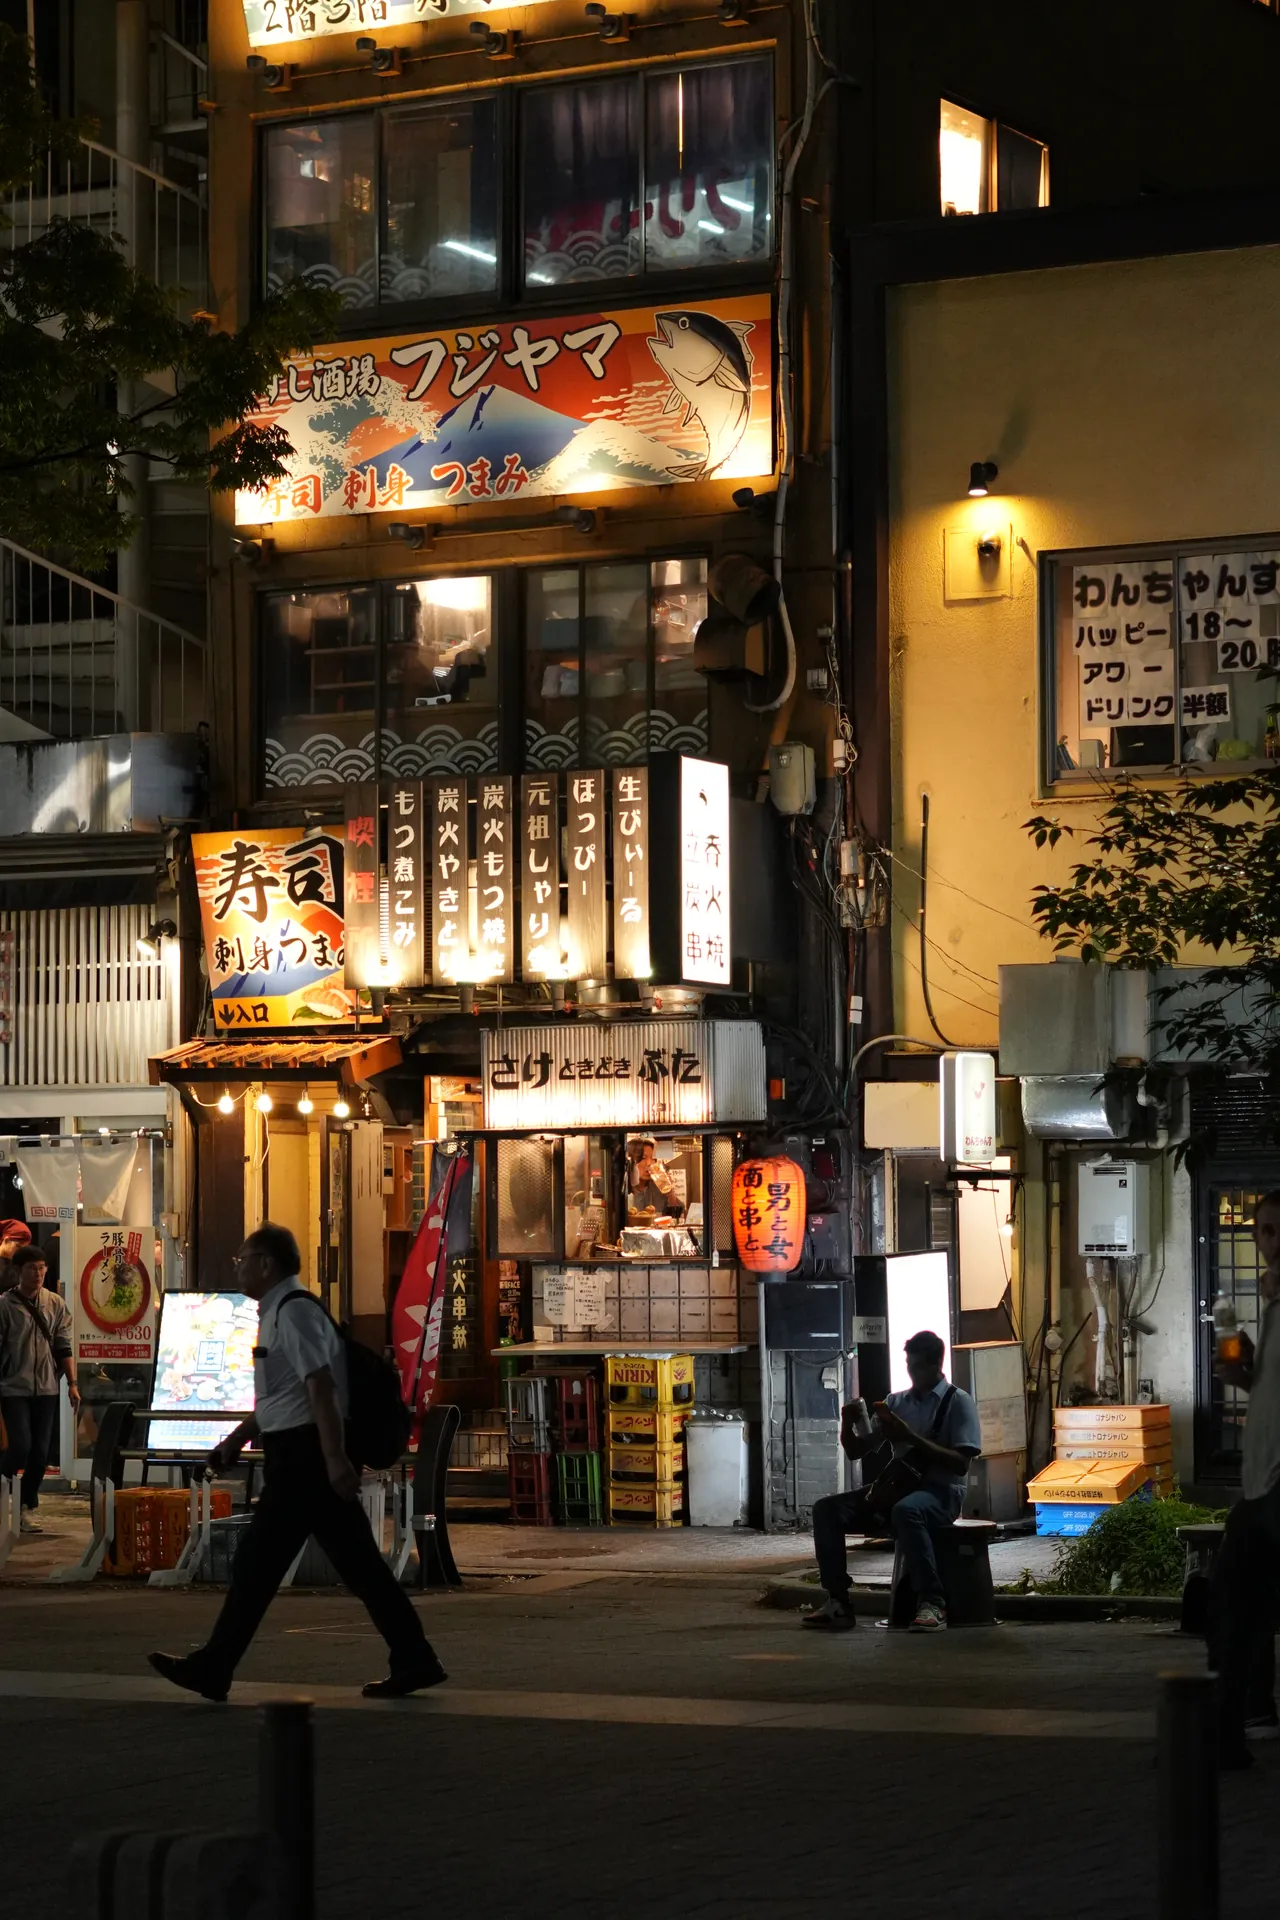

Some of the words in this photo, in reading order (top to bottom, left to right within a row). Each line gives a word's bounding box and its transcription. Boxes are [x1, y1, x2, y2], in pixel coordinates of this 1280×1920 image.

[390, 320, 622, 401] フジヤマ
[342, 464, 413, 510] 刺身
[432, 453, 529, 497] つまみ
[1075, 621, 1167, 648] ハッピー
[1083, 662, 1163, 685] アワー
[1087, 695, 1175, 721] ドリンク
[1183, 692, 1229, 719] 半額
[573, 778, 596, 895] ほっぴー
[214, 836, 345, 923] 寿司
[394, 790, 416, 948] もつ煮こみ
[236, 1003, 270, 1023] 入口
[736, 1168, 763, 1251] 酒と串と
[762, 1183, 793, 1260] 男と女
[100, 1231, 111, 1283] ラーメン
[614, 1369, 655, 1384] KIRIN
